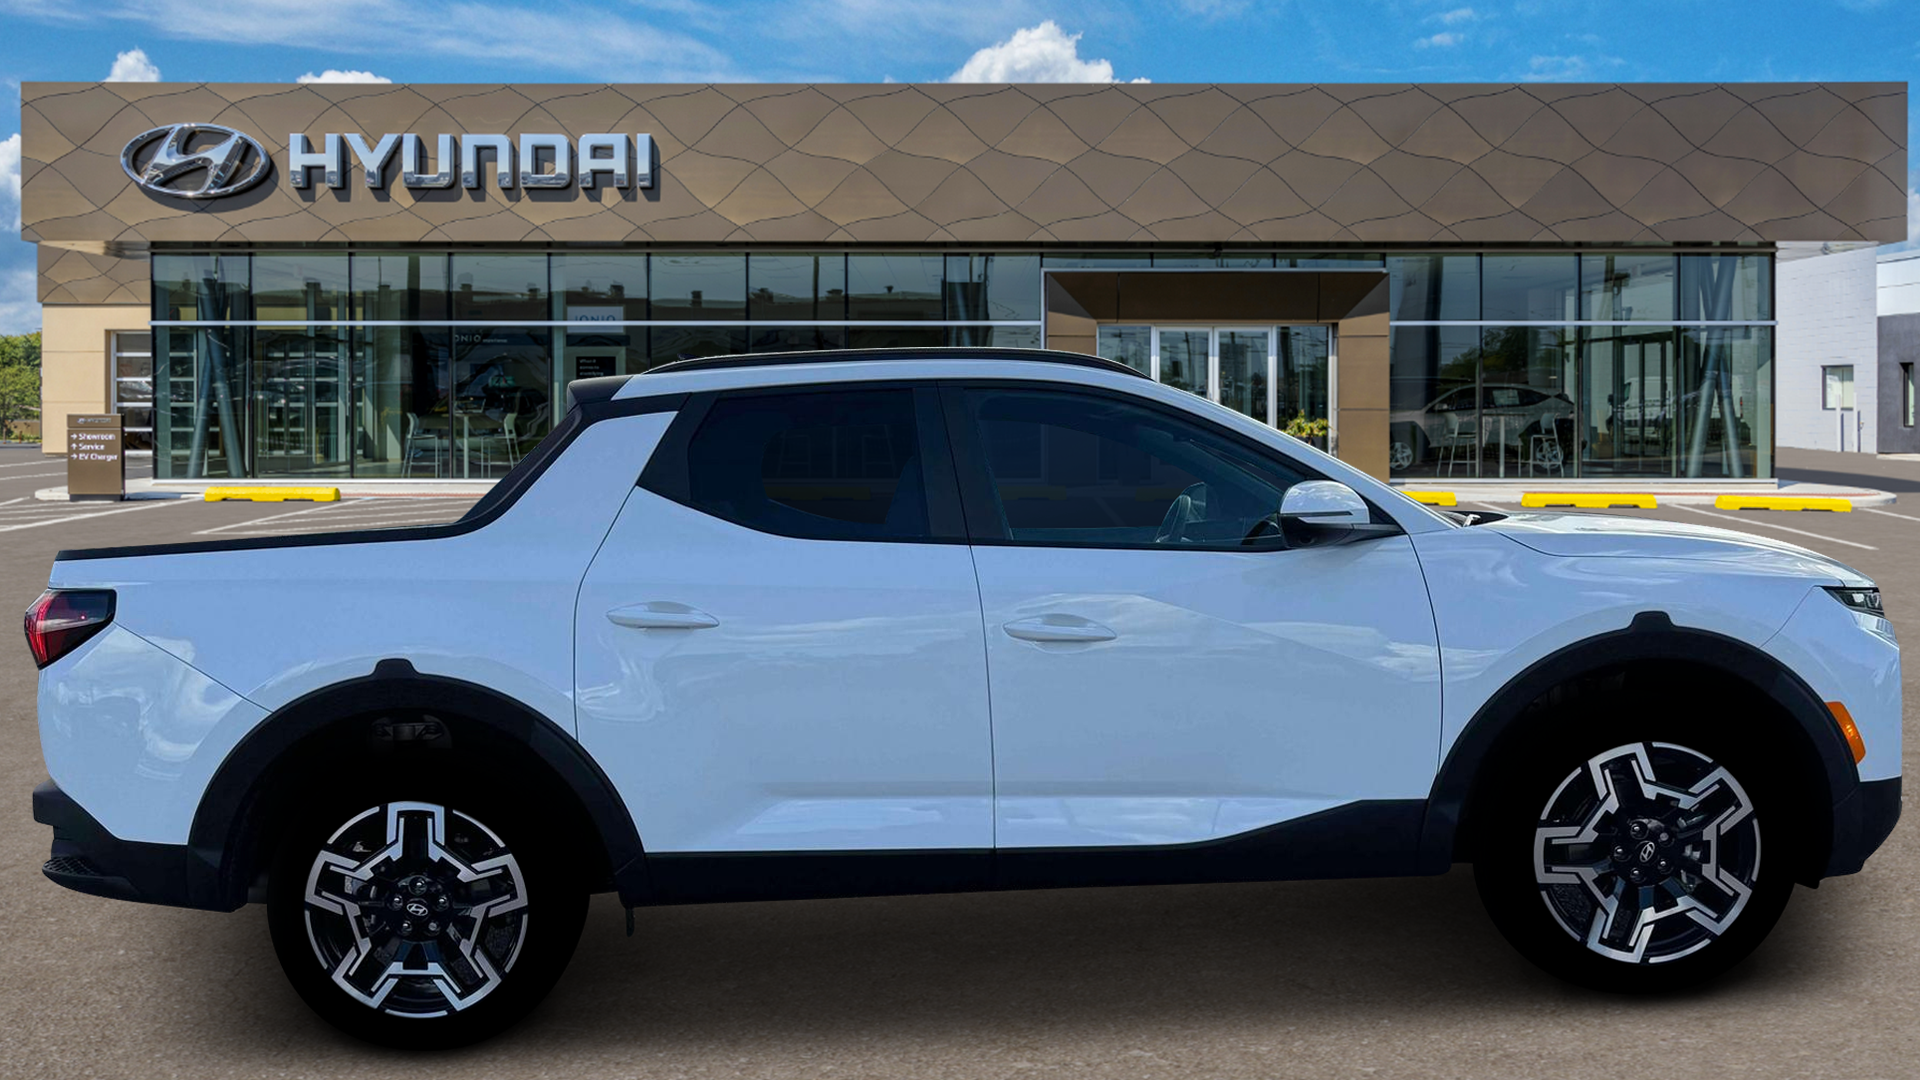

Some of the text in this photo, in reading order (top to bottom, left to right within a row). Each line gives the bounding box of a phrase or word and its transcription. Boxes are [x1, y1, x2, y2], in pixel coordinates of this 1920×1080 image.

[288, 132, 653, 189] HYUNDAI
[78, 432, 115, 440] Showroom
[78, 442, 105, 450] Service
[90, 453, 118, 462] Charger
